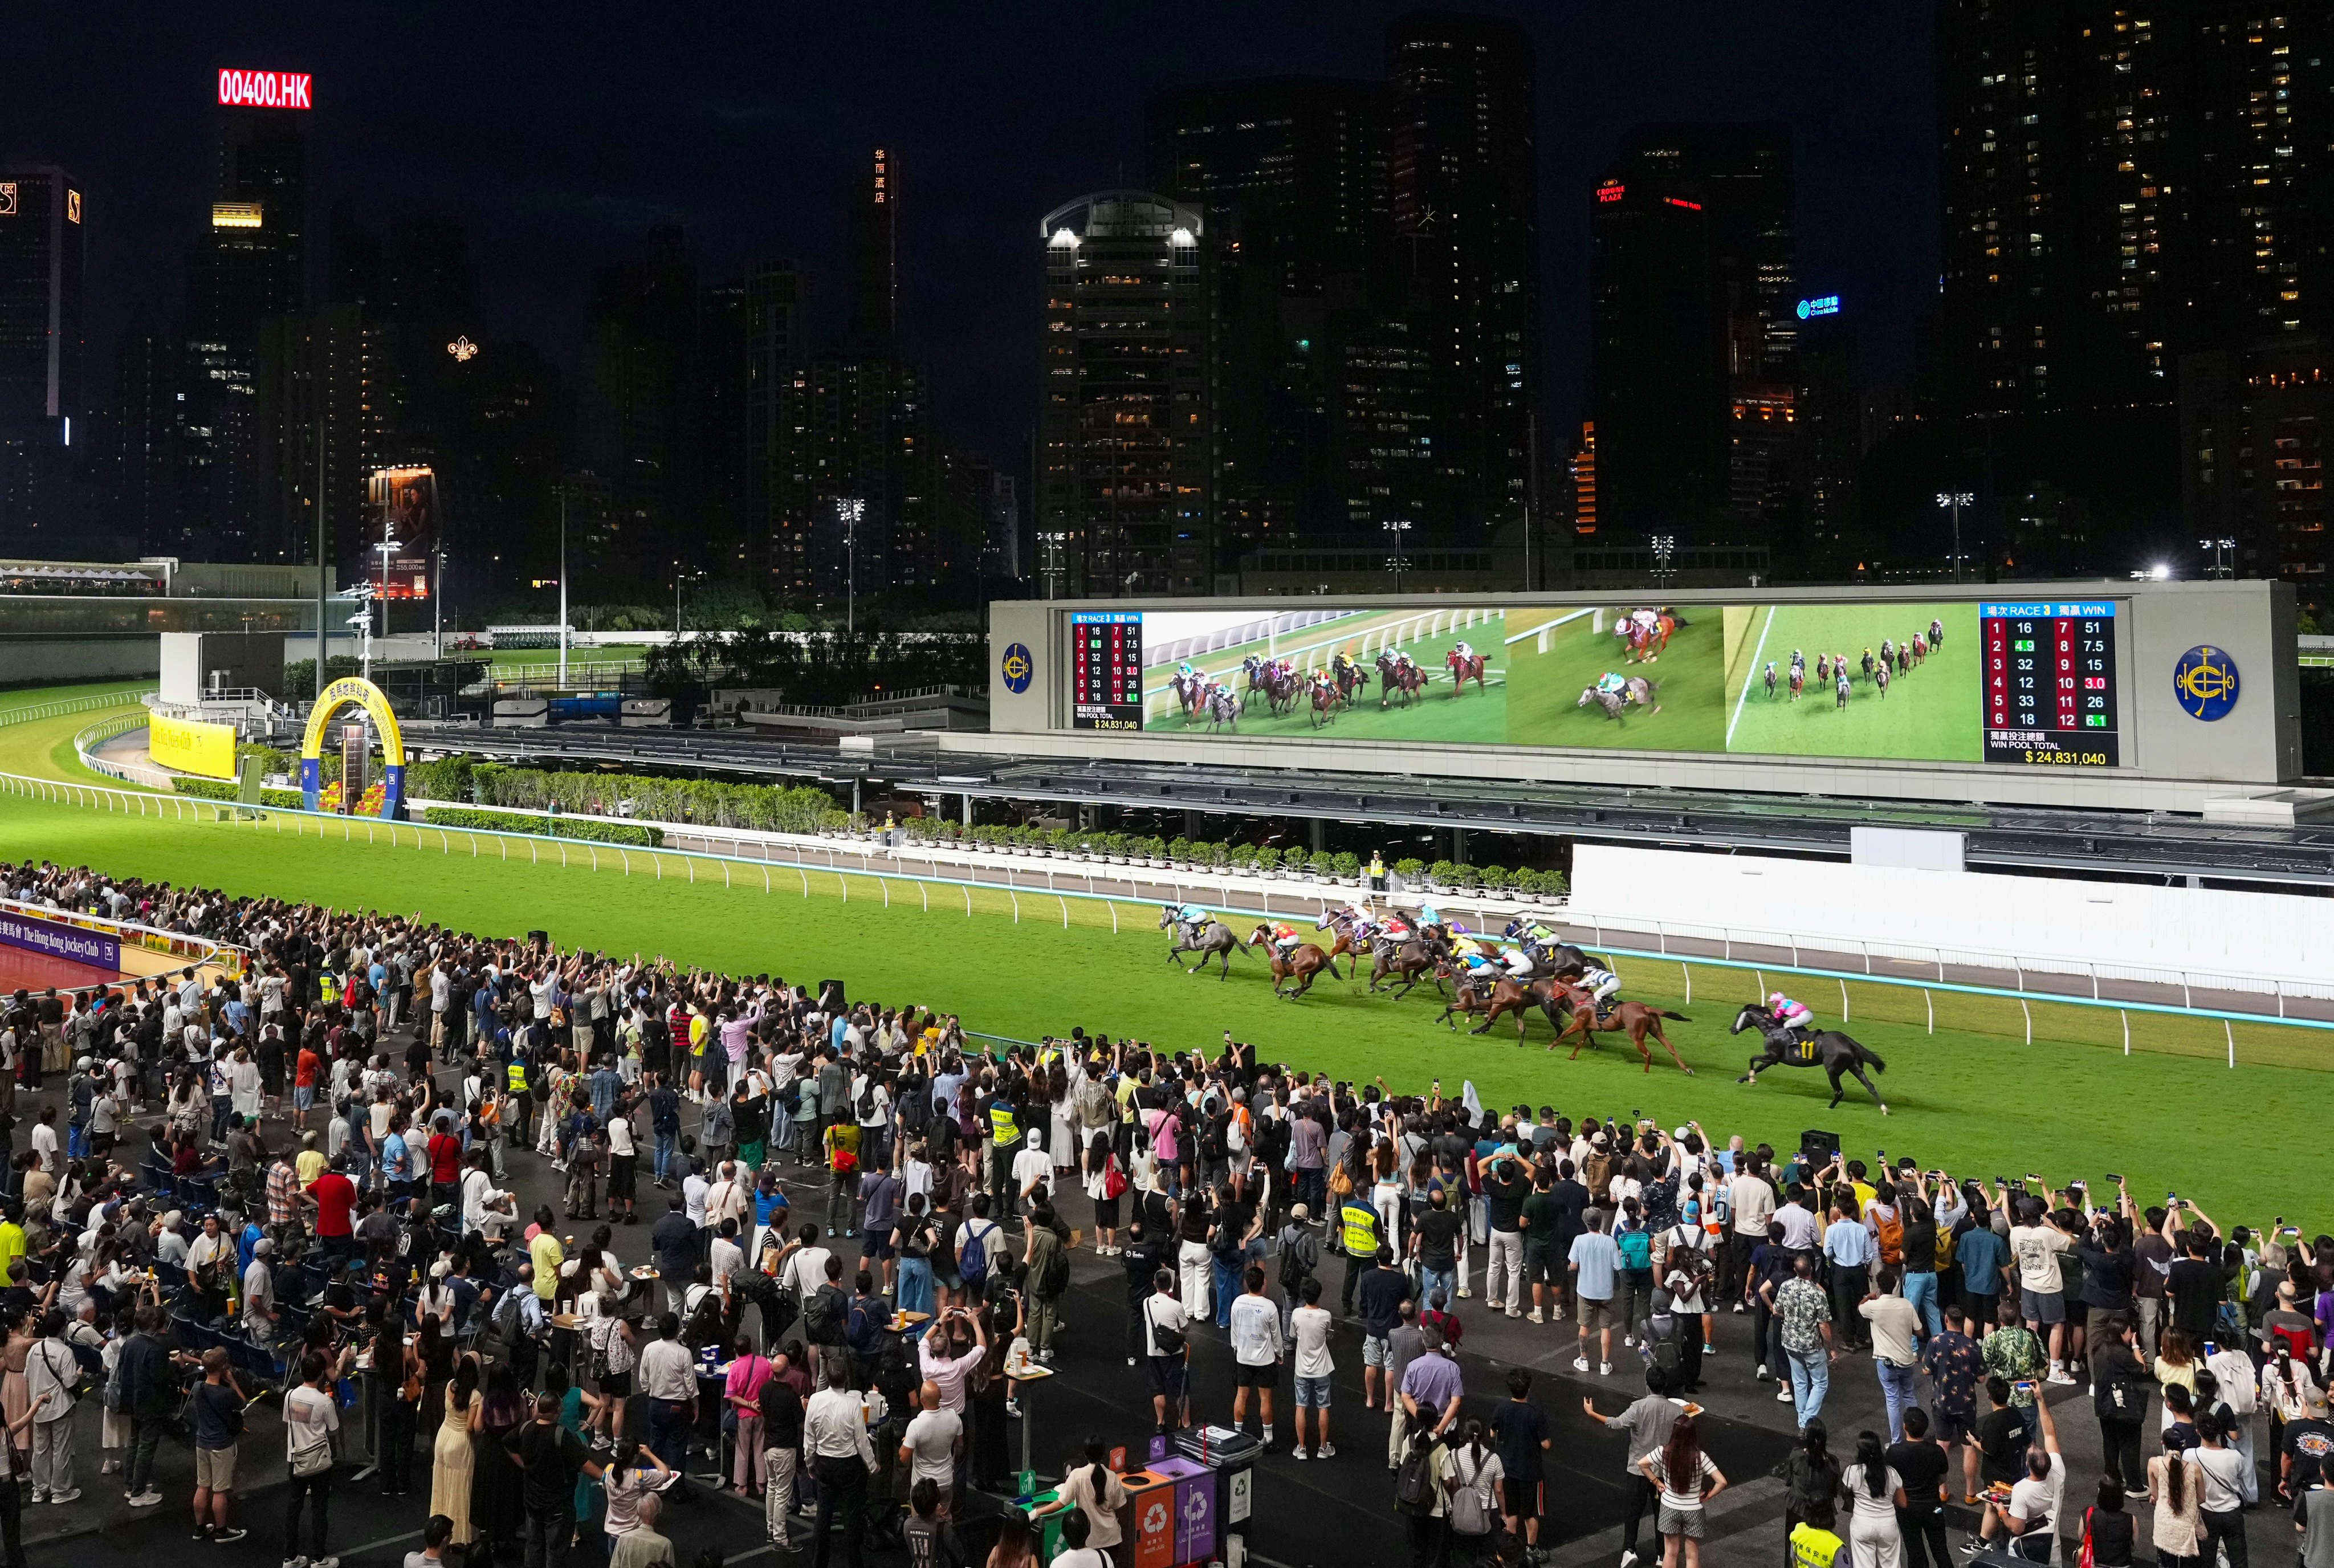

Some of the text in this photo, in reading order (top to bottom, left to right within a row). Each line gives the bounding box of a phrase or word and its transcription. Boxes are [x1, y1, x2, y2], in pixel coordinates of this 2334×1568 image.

[220, 70, 310, 107] 00400.HK
[874, 149, 885, 203] 华丽酒店
[1597, 185, 1624, 196] CROWNE
[1600, 193, 1622, 202] PLAZA
[1811, 296, 1838, 309] 中國移動
[1987, 605, 2050, 616] 場次 RACE 3
[2059, 606, 2105, 616] 獨贏 WIN
[1994, 622, 2099, 633] 1 16 7 51
[1127, 640, 1137, 649] 7.5
[1993, 641, 2103, 651] 2 4.9 8 7.5
[1994, 659, 2102, 670] 3 32 9 15
[1994, 677, 2105, 689] 4 12 10 3.0
[329, 682, 369, 704] 跑馬地煞科夜
[1995, 695, 2103, 707] 5 33 11 26
[308, 712, 317, 730] VALLEY
[316, 697, 325, 712] FINALE
[373, 698, 383, 714] HAPPY
[381, 713, 391, 733] VALLEY
[1101, 721, 1137, 730] 24,831,040
[1995, 714, 2105, 726] 6 18 12 6.1
[181, 732, 190, 750] Club
[1990, 731, 2044, 741] 獨贏投注總額
[2026, 751, 2105, 764] $ 24,831,040
[24, 927, 99, 958] The Hong Kong Jockey Club
[1489, 981, 1496, 994] 7
[1800, 1041, 1815, 1060] 11
